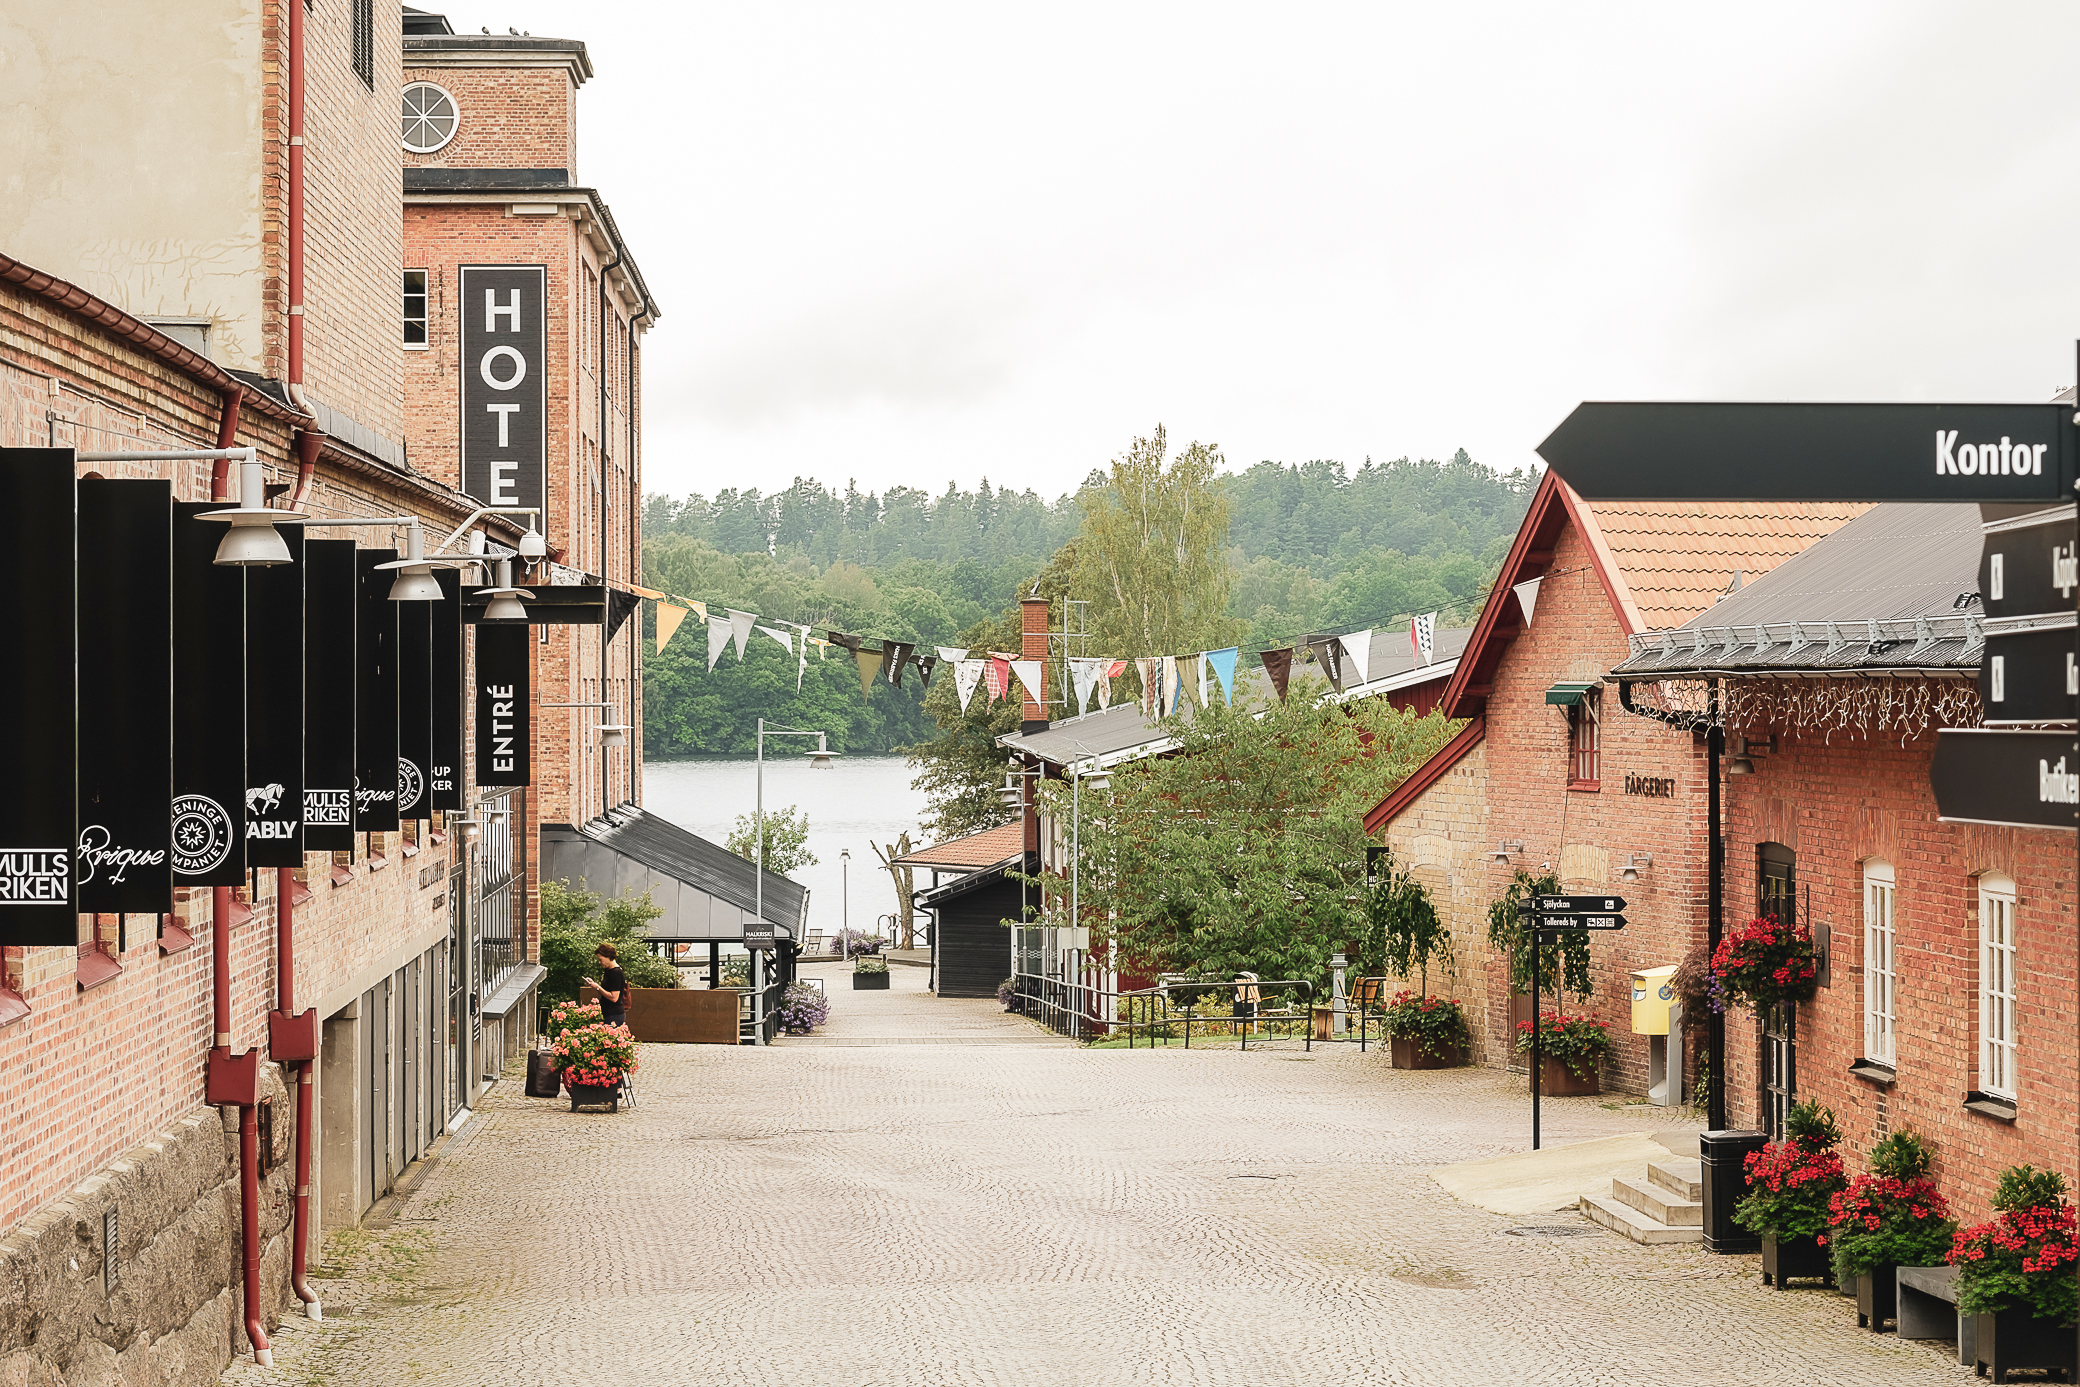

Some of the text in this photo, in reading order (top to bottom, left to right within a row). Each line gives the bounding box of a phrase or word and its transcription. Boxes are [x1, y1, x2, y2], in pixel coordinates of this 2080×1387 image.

[480, 288, 527, 506] HOTE
[1936, 429, 2048, 476] Kontor
[486, 684, 514, 772] ENTRÉ
[1543, 917, 1569, 926] Tollereds
[1569, 917, 1578, 927] by
